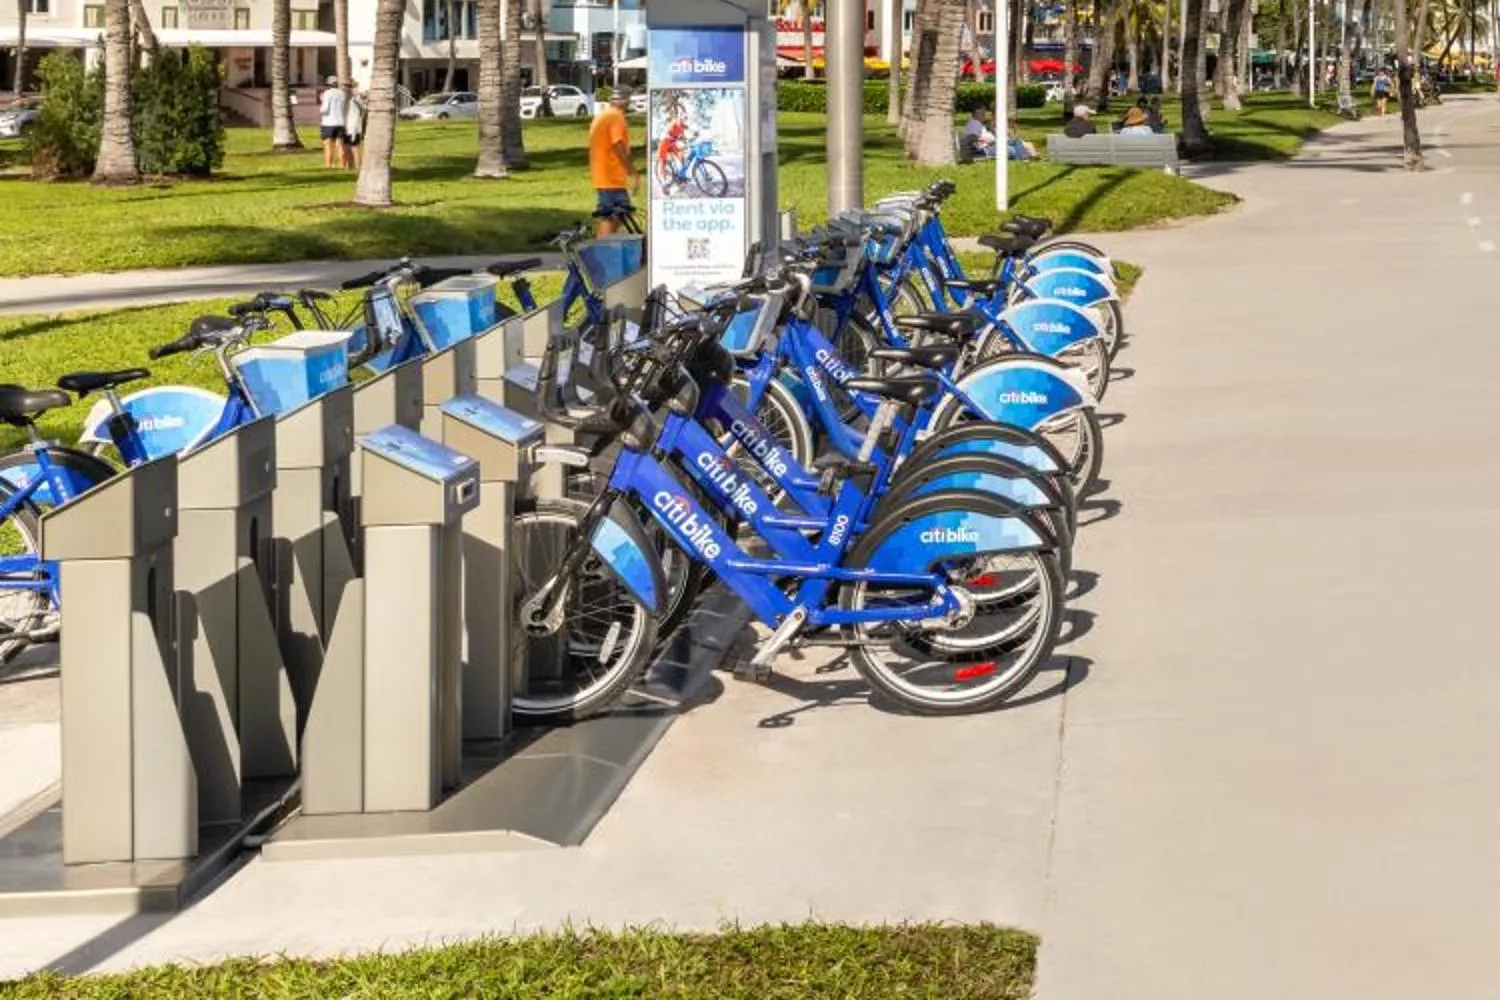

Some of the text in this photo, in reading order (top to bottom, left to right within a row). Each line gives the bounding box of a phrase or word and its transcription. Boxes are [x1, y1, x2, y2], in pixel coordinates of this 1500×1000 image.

[662, 200, 735, 215] Rent via
[662, 218, 736, 234] the app.
